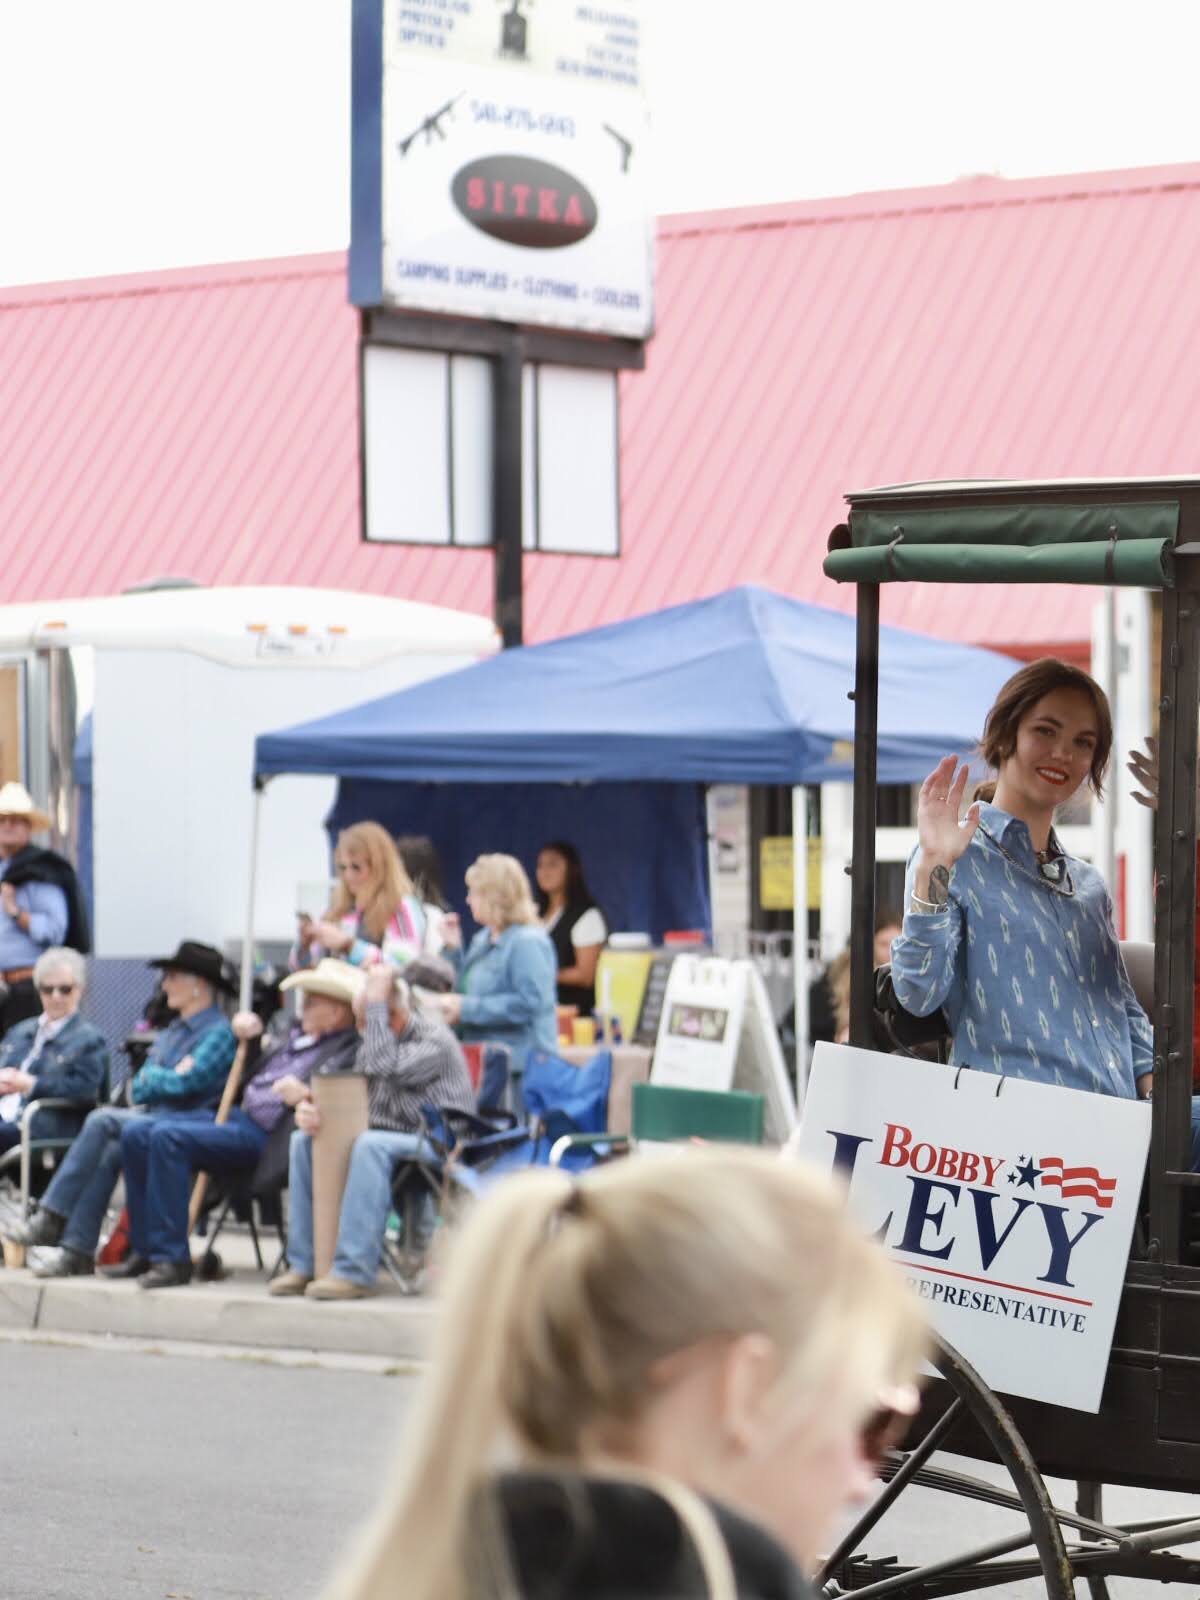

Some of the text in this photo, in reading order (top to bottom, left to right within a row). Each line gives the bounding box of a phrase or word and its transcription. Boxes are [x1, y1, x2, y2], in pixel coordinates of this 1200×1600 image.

[466, 177, 584, 225] SITKA
[397, 259, 450, 283] CAMPING
[455, 267, 508, 291] SUPPLIES
[524, 275, 577, 299] CLOTHING
[877, 1122, 1006, 1188] BOBBY
